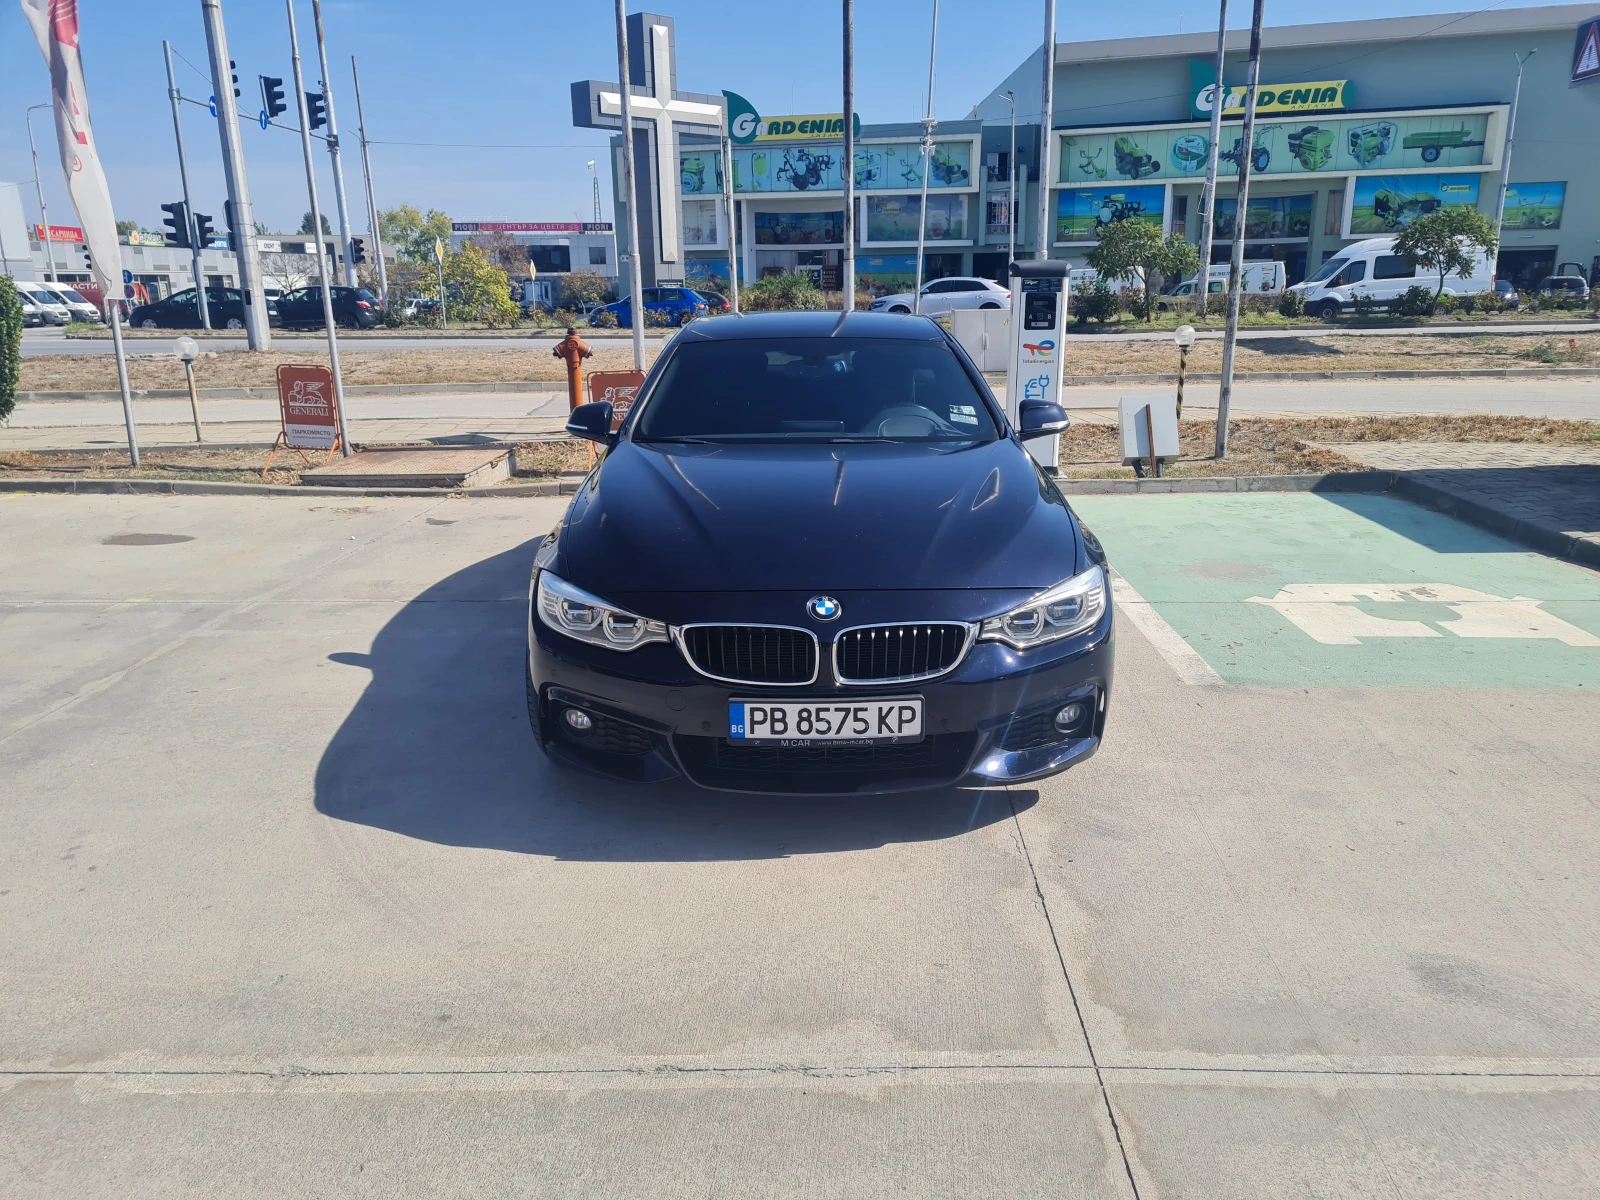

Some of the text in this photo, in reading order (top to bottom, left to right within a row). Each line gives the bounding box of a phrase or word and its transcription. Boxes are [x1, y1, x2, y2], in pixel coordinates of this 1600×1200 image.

[1291, 102, 1335, 110] ANTANA
[732, 113, 844, 138] GARDENIA
[541, 223, 565, 231] ЦВЕТЯ
[290, 407, 329, 416] GENERALI
[796, 706, 870, 735] 8575
[731, 724, 744, 734] BG
[780, 739, 789, 747] M
[791, 739, 811, 747] CAR
